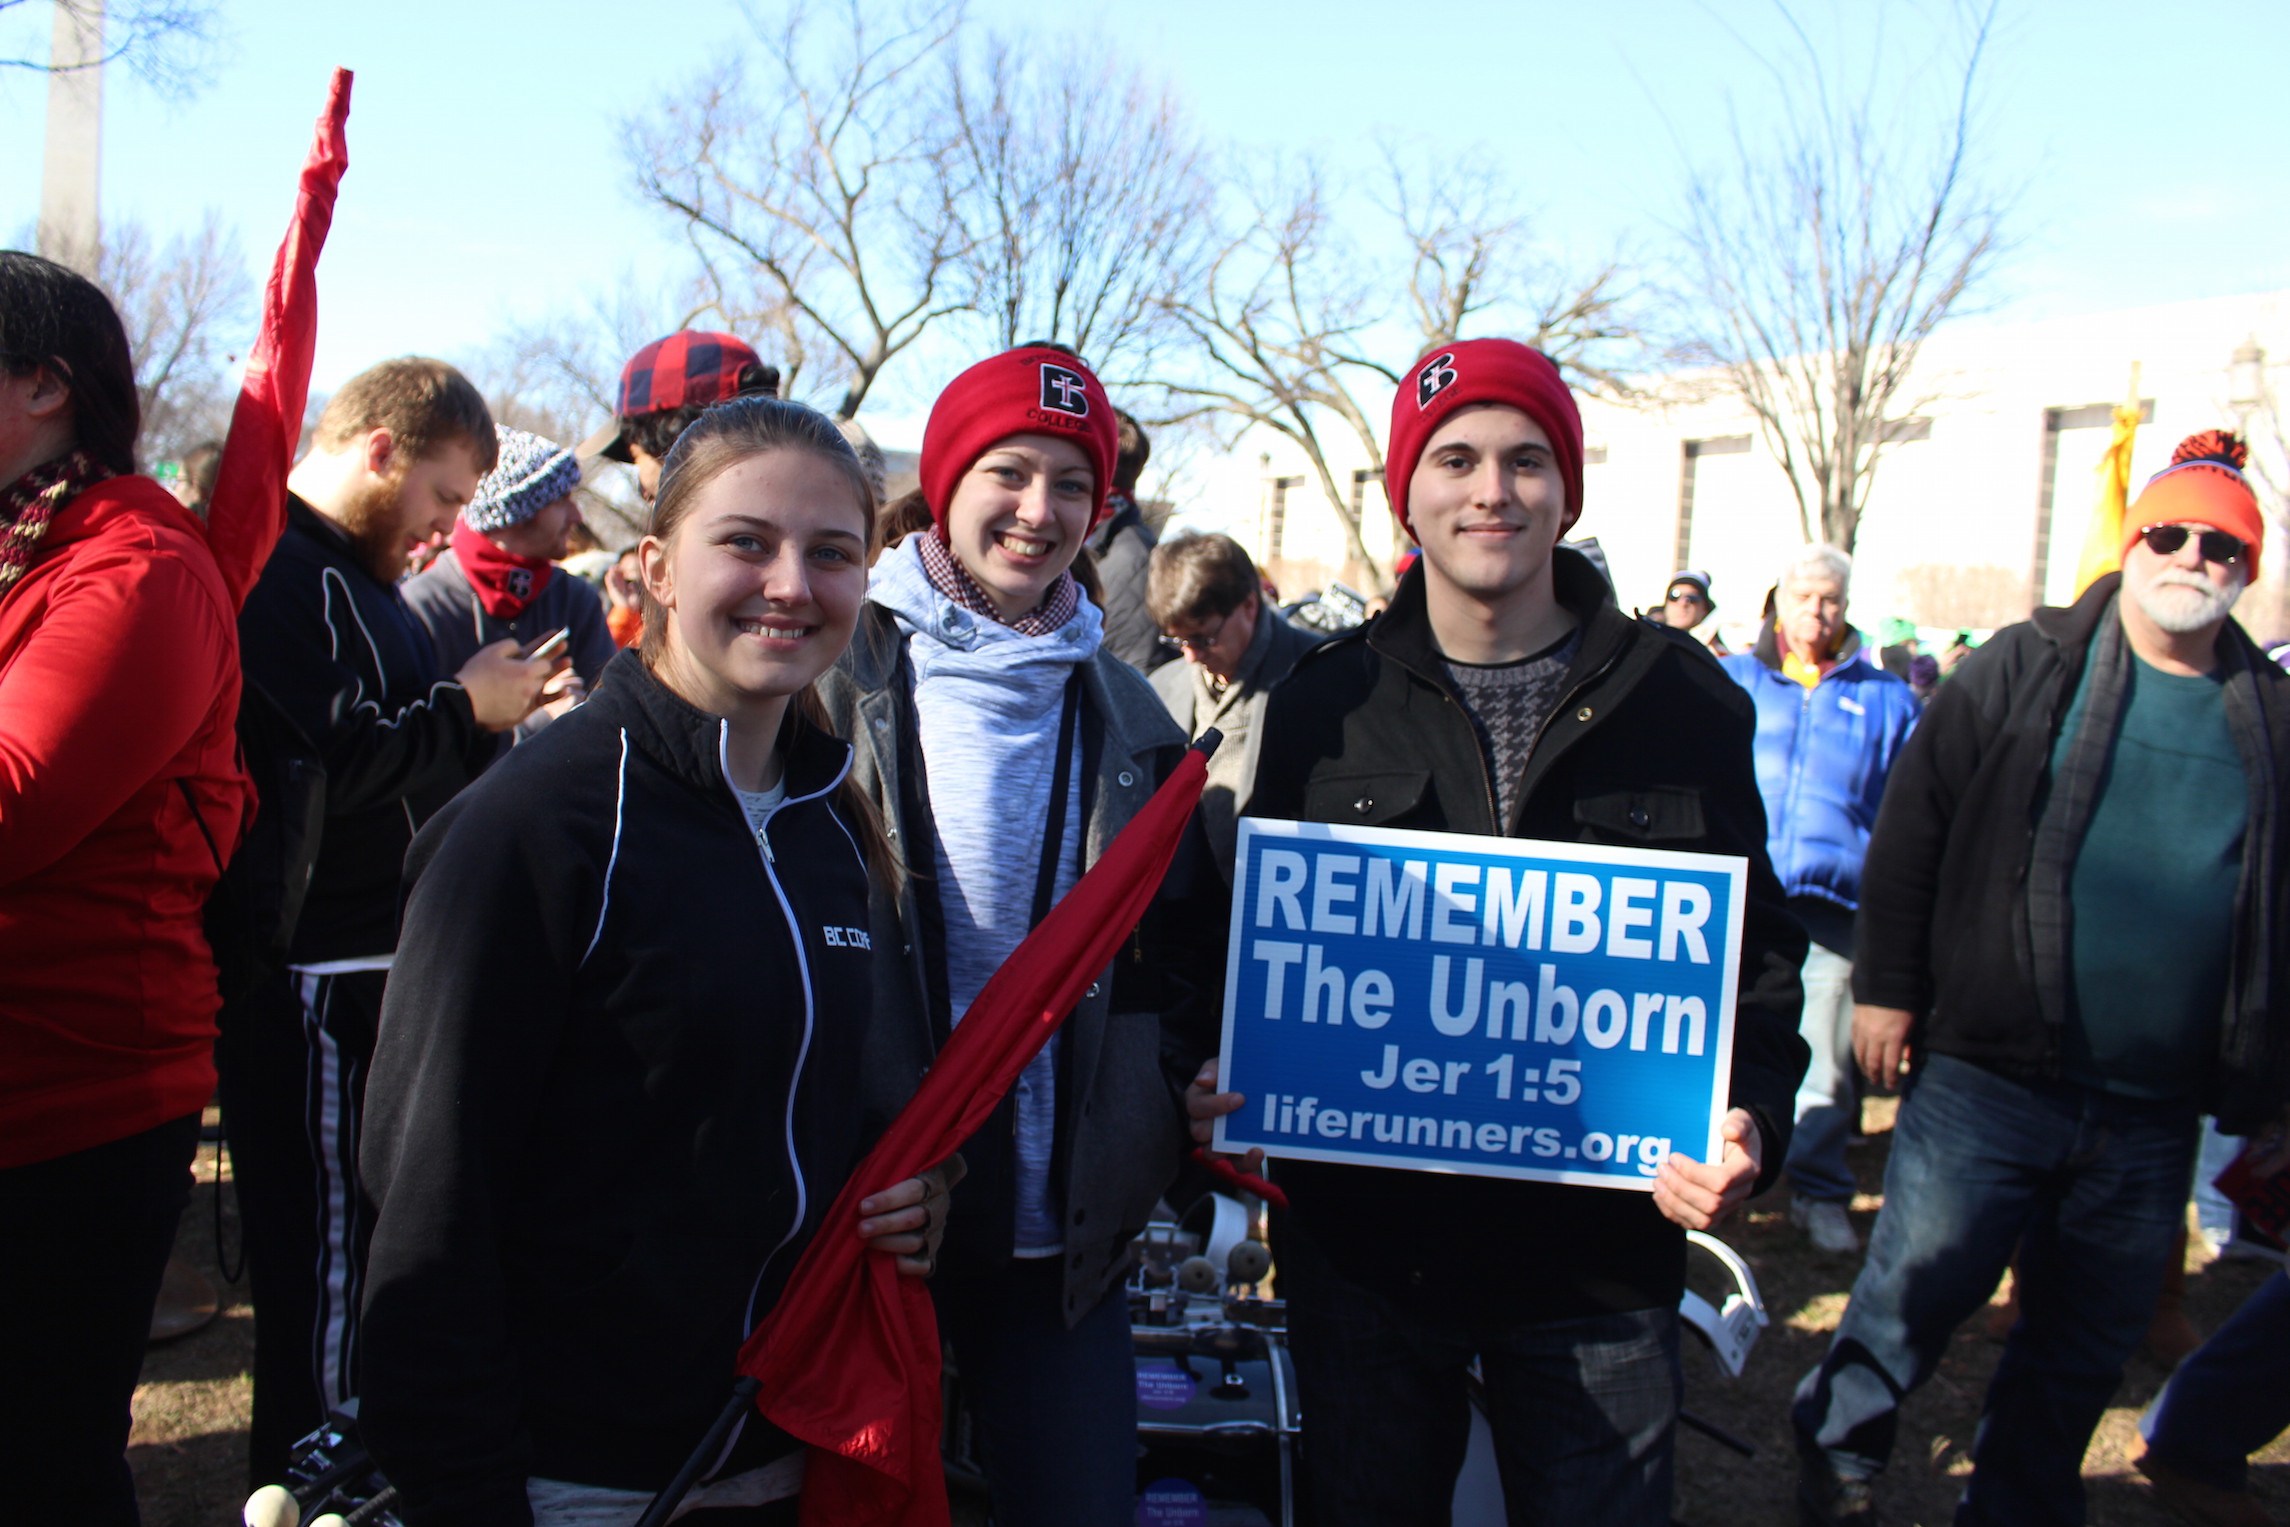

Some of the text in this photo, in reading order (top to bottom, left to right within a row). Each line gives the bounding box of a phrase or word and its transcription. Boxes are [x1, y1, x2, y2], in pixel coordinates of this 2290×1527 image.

[823, 926, 847, 946] BC
[1255, 848, 1712, 964] REMEMBER
[1253, 939, 1707, 1056] The Unborn
[1361, 1044, 1582, 1105] Jer 1:5
[1262, 1093, 1671, 1177] liferunners.org
